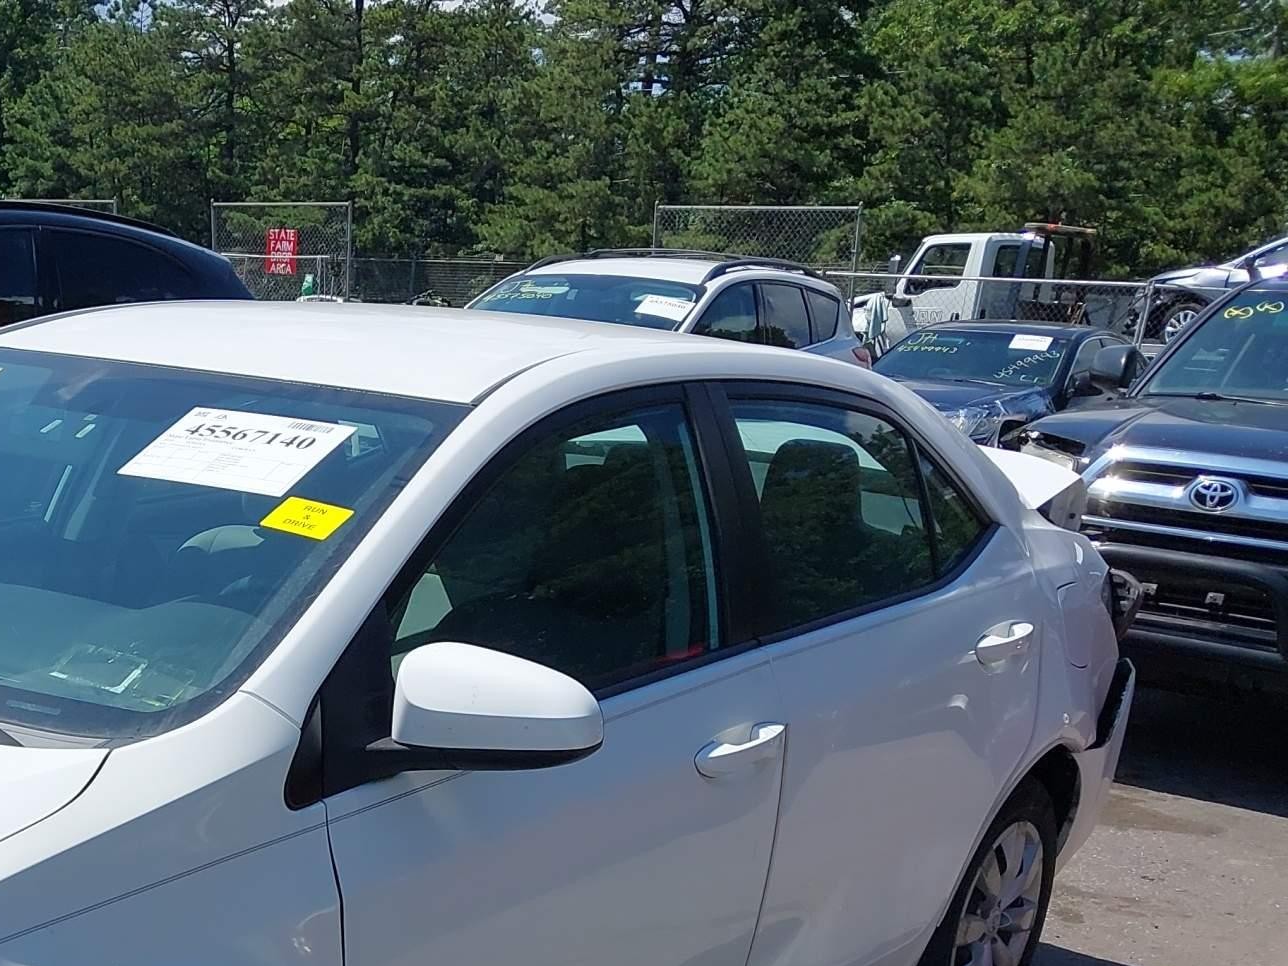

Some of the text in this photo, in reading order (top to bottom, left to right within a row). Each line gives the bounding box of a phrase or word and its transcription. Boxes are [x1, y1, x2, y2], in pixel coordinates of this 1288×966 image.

[269, 229, 295, 241] STATE
[270, 241, 294, 252] FARM
[184, 423, 316, 450] 45567140
[304, 505, 328, 515] RUN
[283, 518, 319, 531] DRIVE
